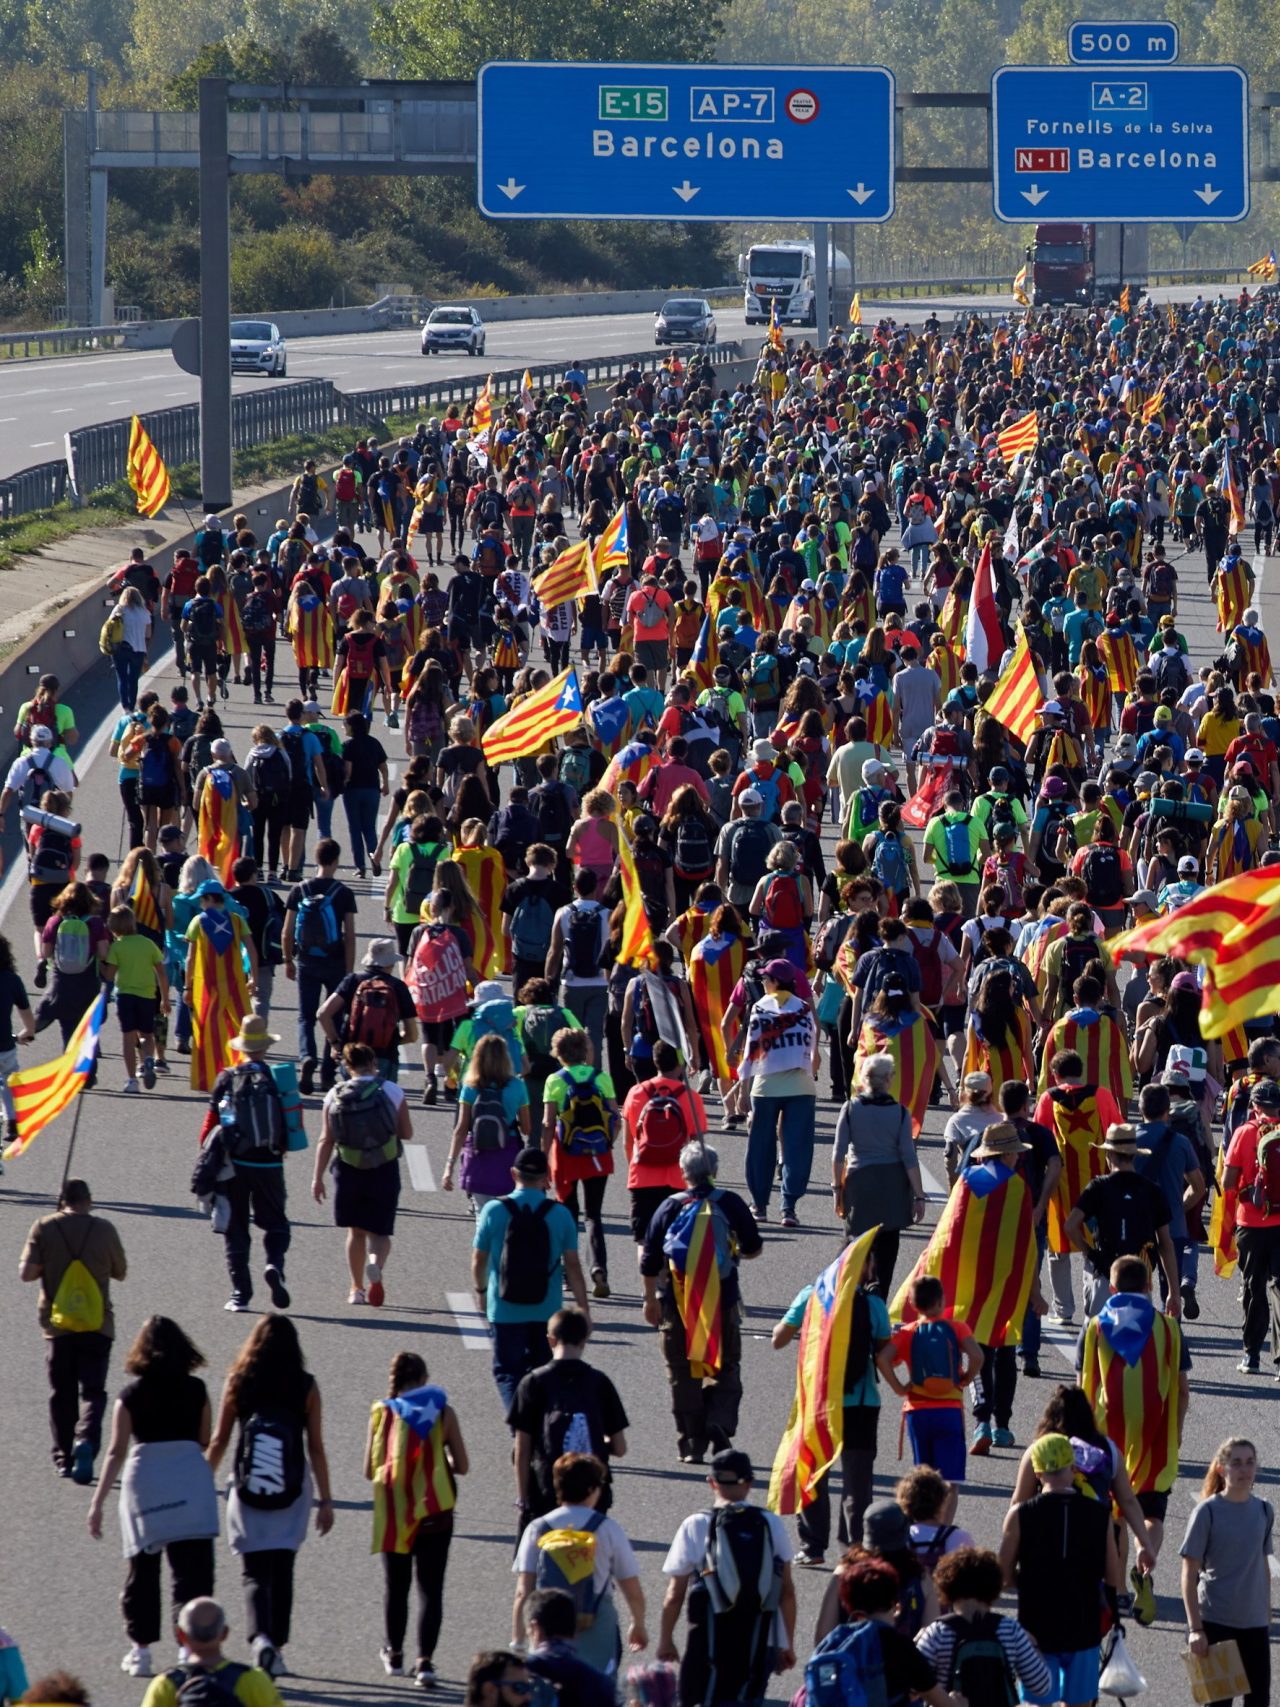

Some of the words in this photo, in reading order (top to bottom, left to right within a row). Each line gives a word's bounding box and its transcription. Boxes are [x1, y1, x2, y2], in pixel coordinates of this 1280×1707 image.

[1081, 33, 1130, 52] 500
[1147, 37, 1167, 51] m
[605, 92, 663, 115] E-15
[698, 93, 768, 116] AP-7
[1098, 87, 1142, 105] A-2
[1027, 119, 1113, 134] Fornells
[1124, 122, 1141, 134] de
[1150, 122, 1163, 134] la
[1171, 121, 1213, 134] Selva
[592, 129, 784, 160] Barcelona
[1078, 149, 1217, 169] Barcelona
[247, 1432, 286, 1496] NIKE
